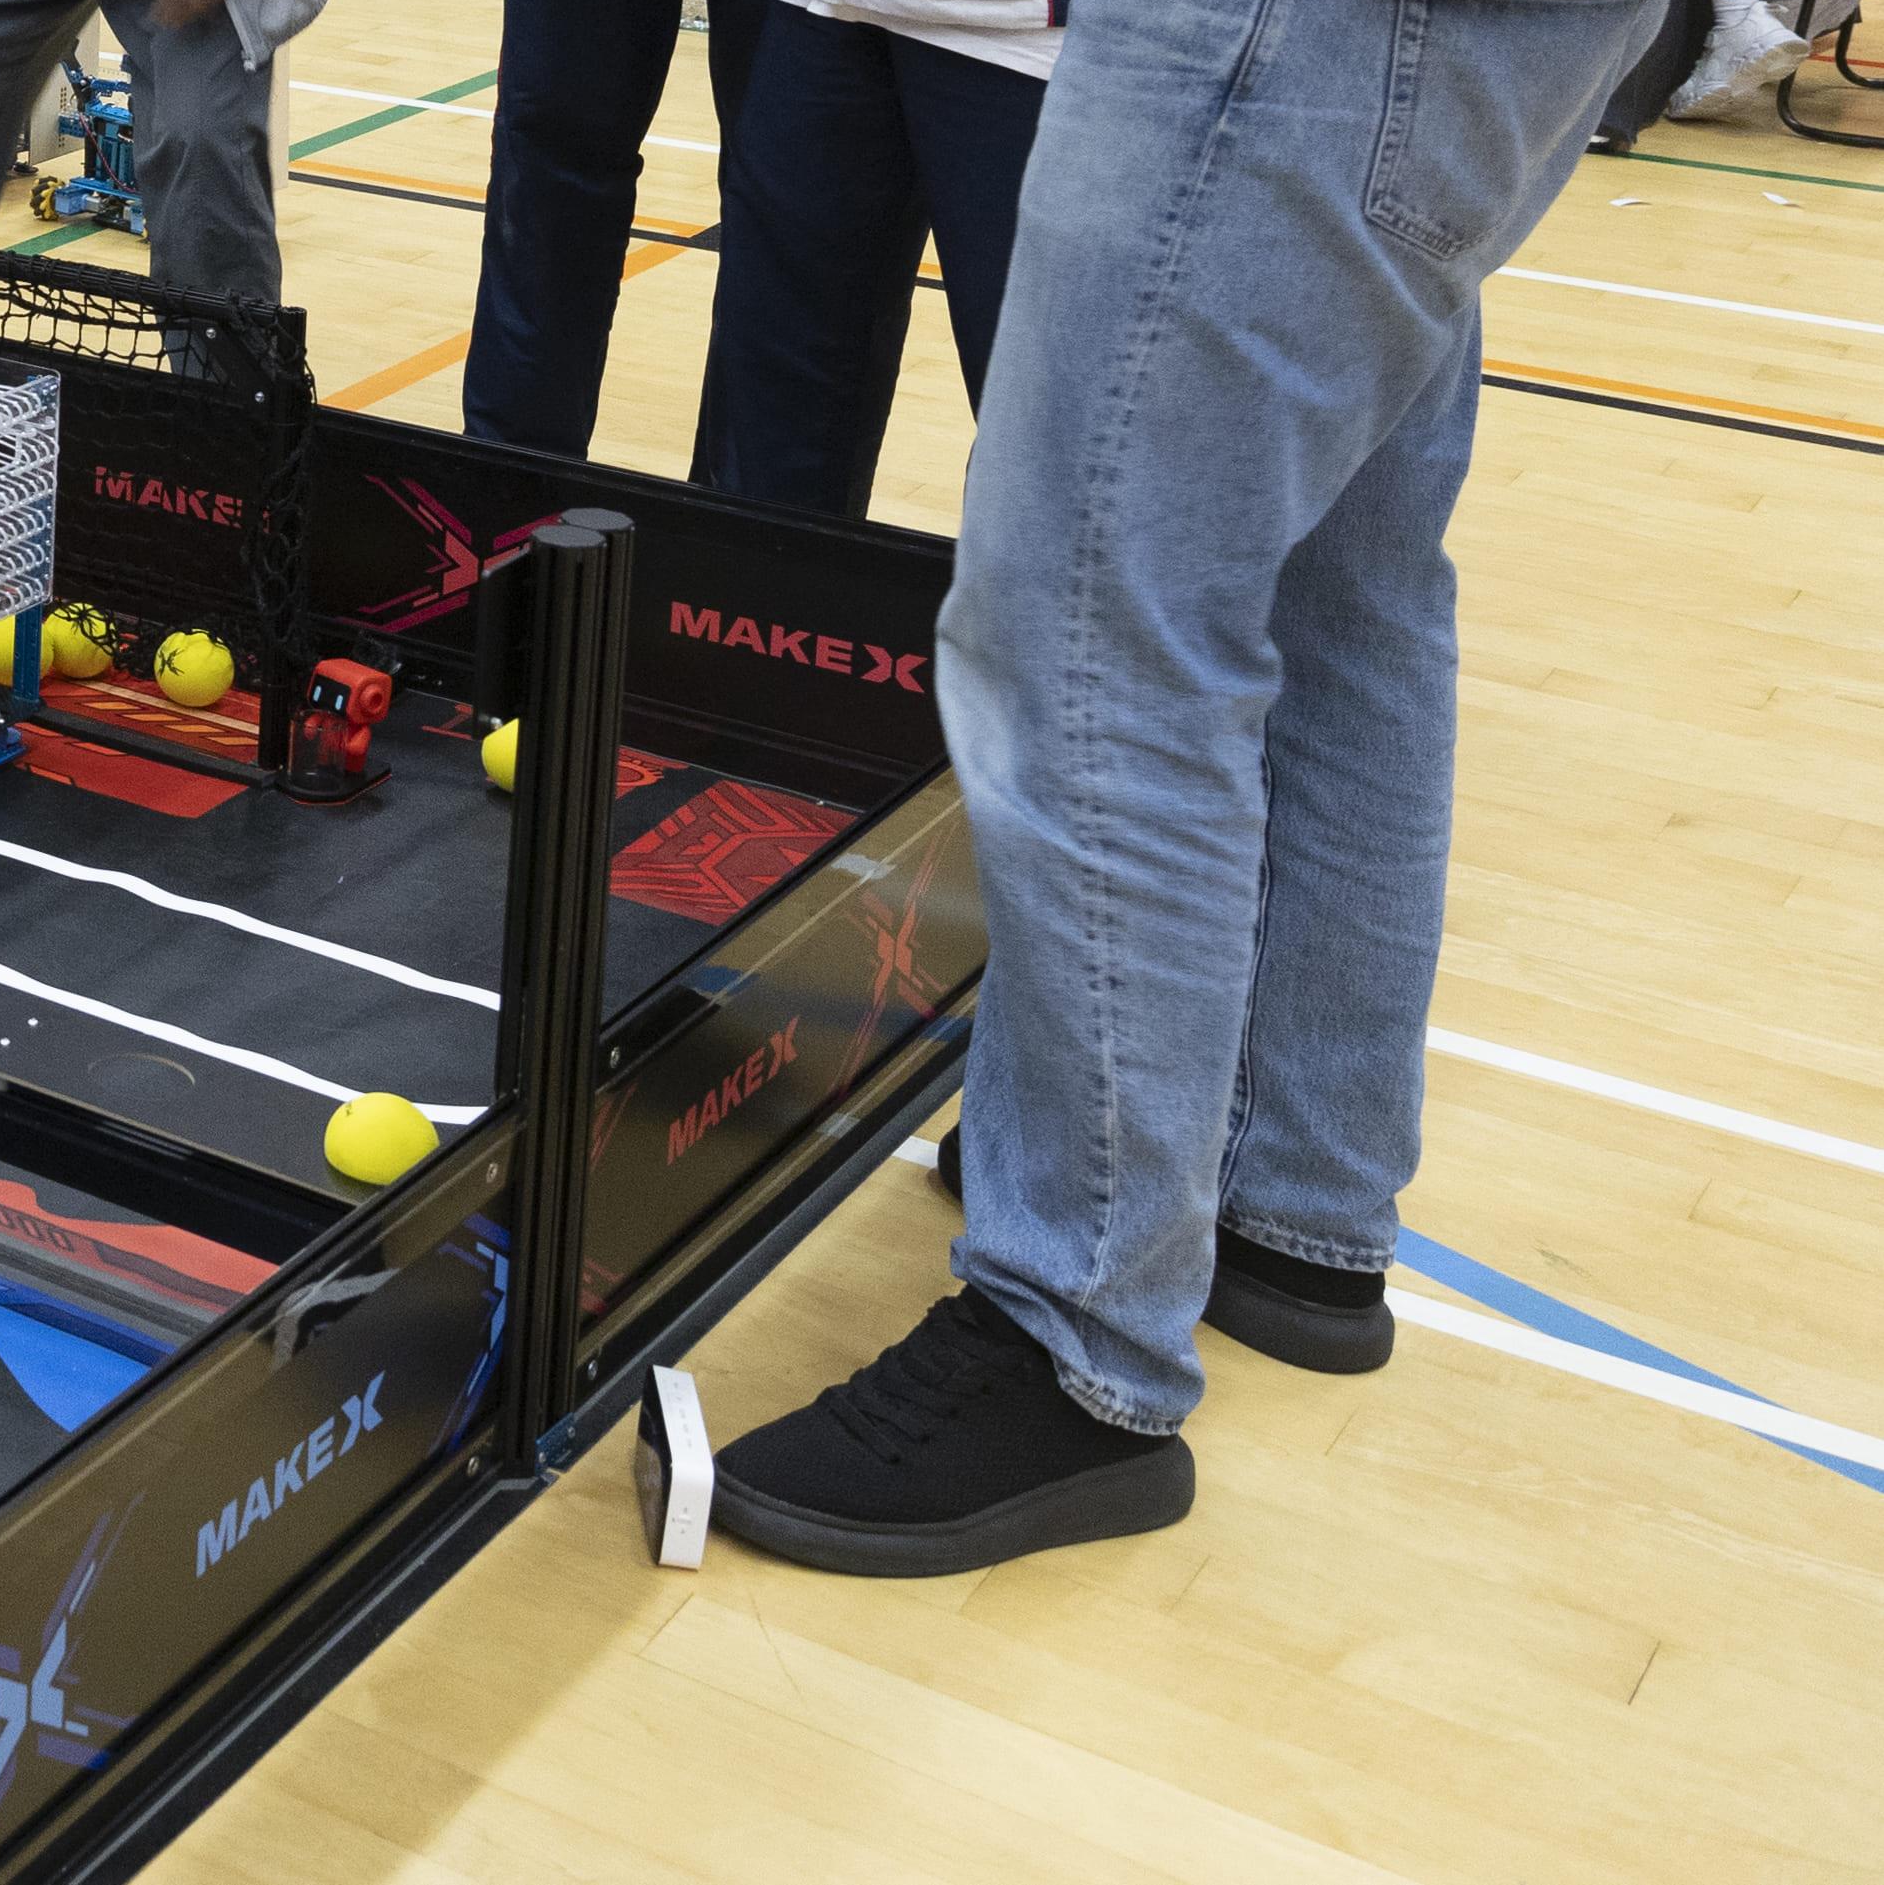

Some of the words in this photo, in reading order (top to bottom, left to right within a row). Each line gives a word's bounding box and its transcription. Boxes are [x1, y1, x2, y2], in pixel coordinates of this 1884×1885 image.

[669, 600, 929, 694] MAKEX
[666, 1017, 799, 1166] MAKEX
[194, 1371, 387, 1579] MAKEX
